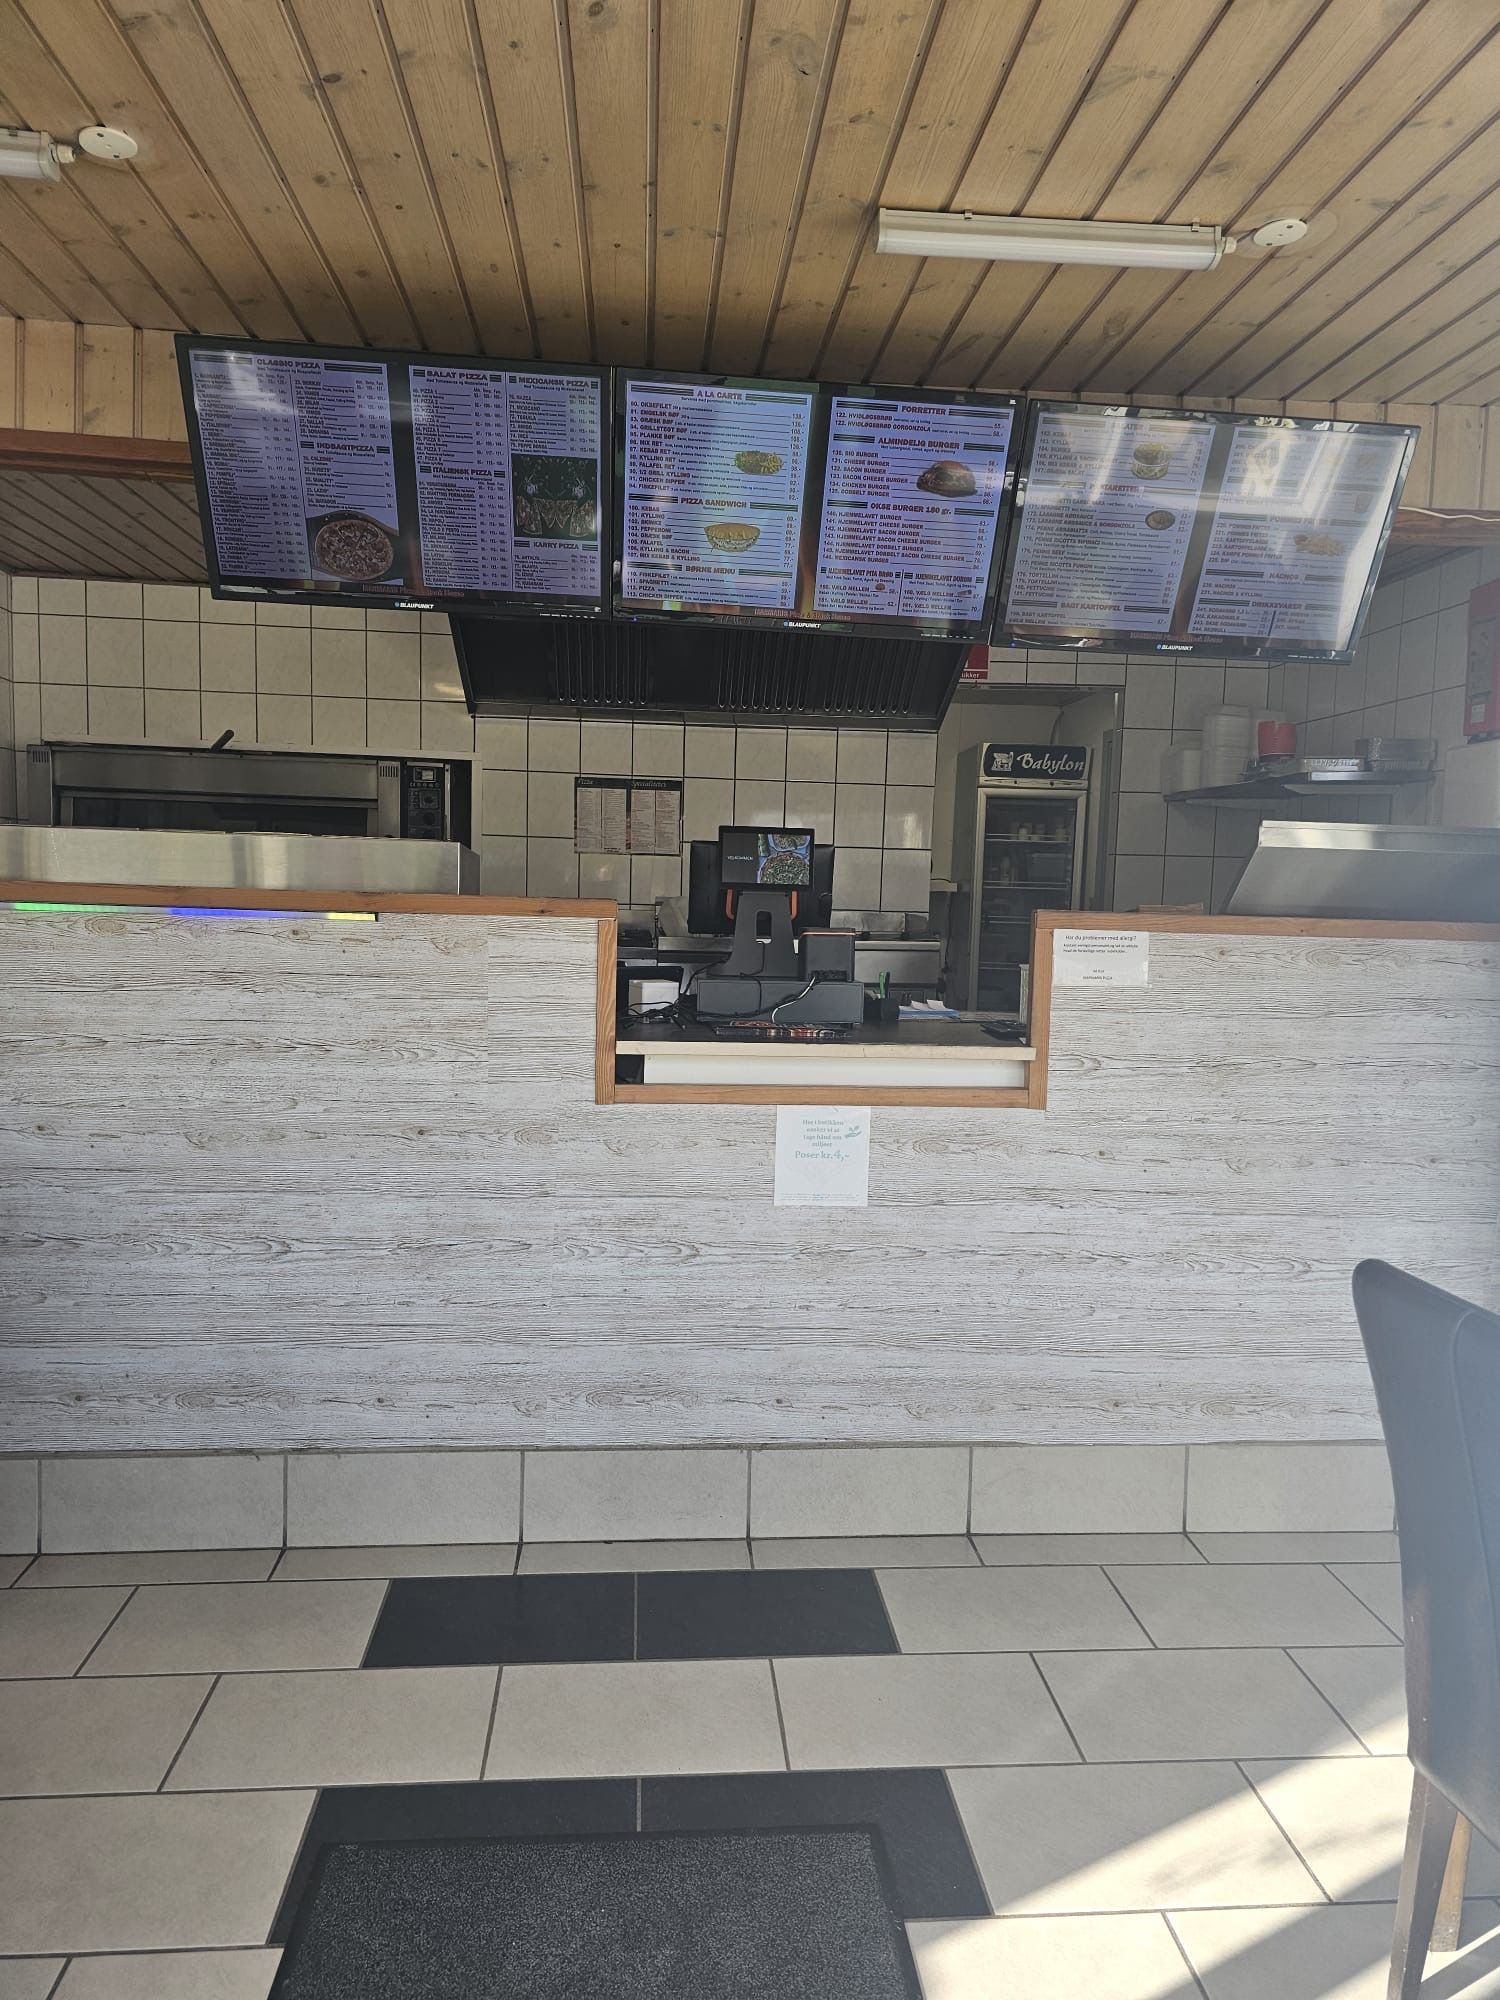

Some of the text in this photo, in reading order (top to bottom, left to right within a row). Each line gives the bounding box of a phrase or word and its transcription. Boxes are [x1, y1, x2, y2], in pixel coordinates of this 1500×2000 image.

[427, 370, 487, 380] SALAT PIZZA
[902, 406, 946, 415] FORRETTER
[878, 437, 959, 449] ALMINDELIG BURGER
[433, 467, 469, 475] ITALIENSK
[705, 500, 746, 508] SANDWICH
[892, 505, 924, 513] BURGER
[915, 573, 951, 581] HJEMMELAVET
[1081, 603, 1120, 612] KARTOFFEL
[1017, 752, 1084, 774] Babylon
